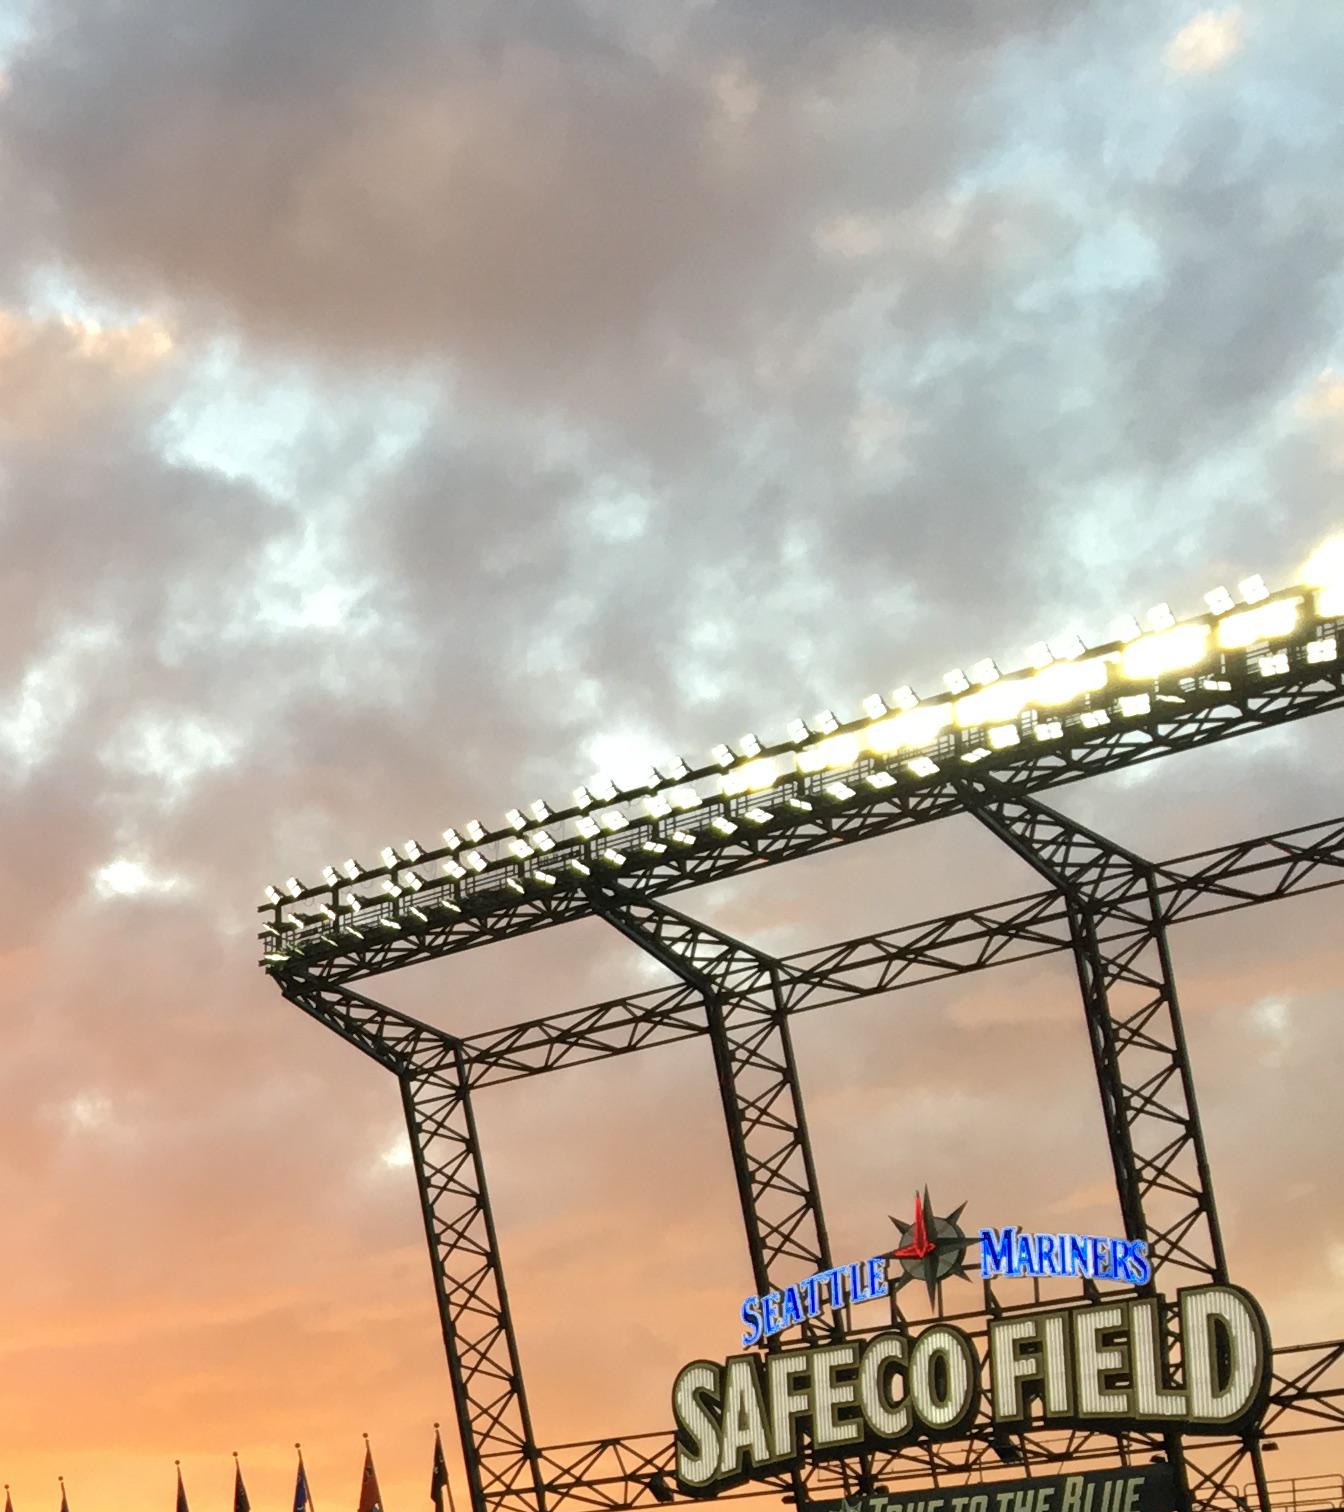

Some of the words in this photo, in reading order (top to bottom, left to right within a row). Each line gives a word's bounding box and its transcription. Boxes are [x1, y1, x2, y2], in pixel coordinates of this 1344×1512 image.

[741, 1255, 889, 1348] SEATTLE
[979, 1226, 1153, 1286] MARINERS
[674, 1323, 976, 1490] SAFECO
[992, 1287, 1267, 1426] FIELD
